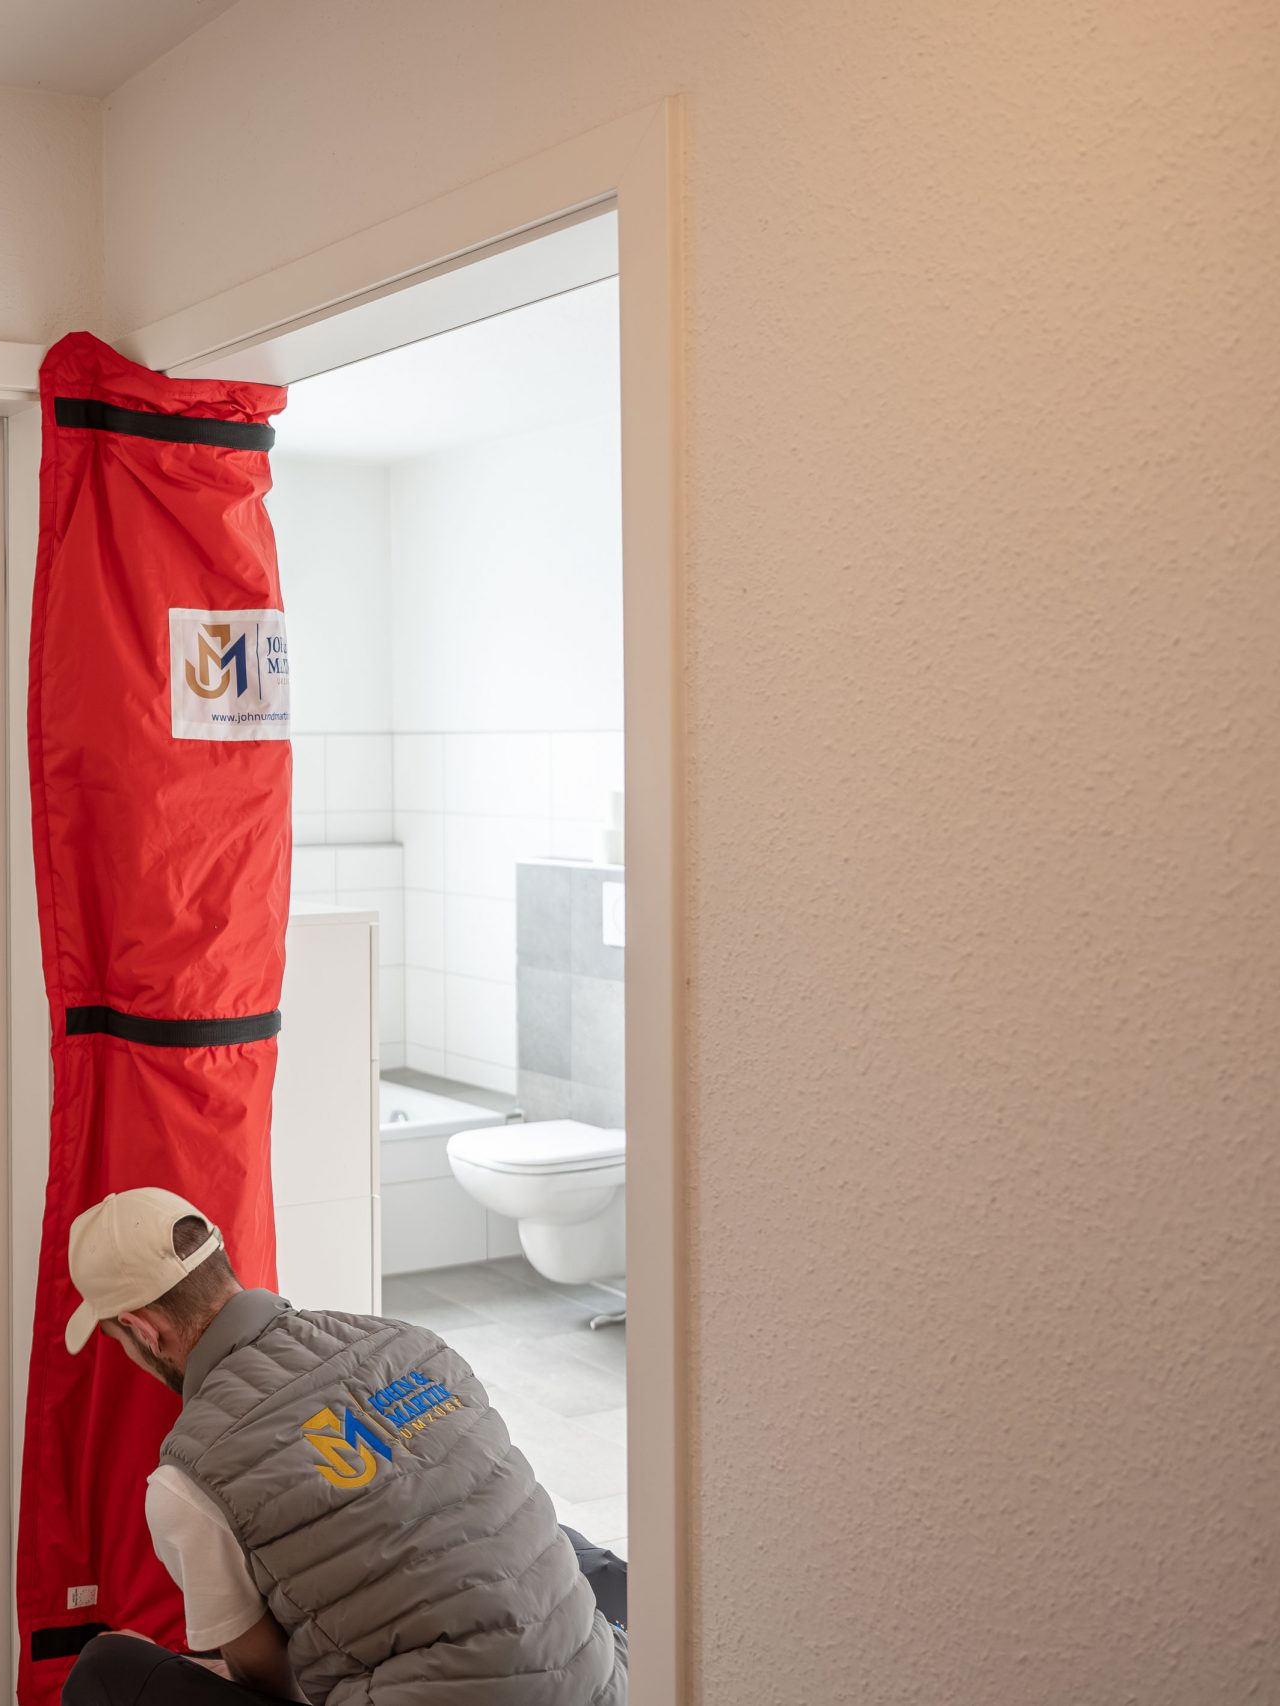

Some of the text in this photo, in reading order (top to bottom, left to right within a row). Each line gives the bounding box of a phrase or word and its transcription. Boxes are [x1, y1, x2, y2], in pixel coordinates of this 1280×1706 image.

[367, 1370, 431, 1416] JOHN &
[385, 1383, 451, 1428] MARTIN
